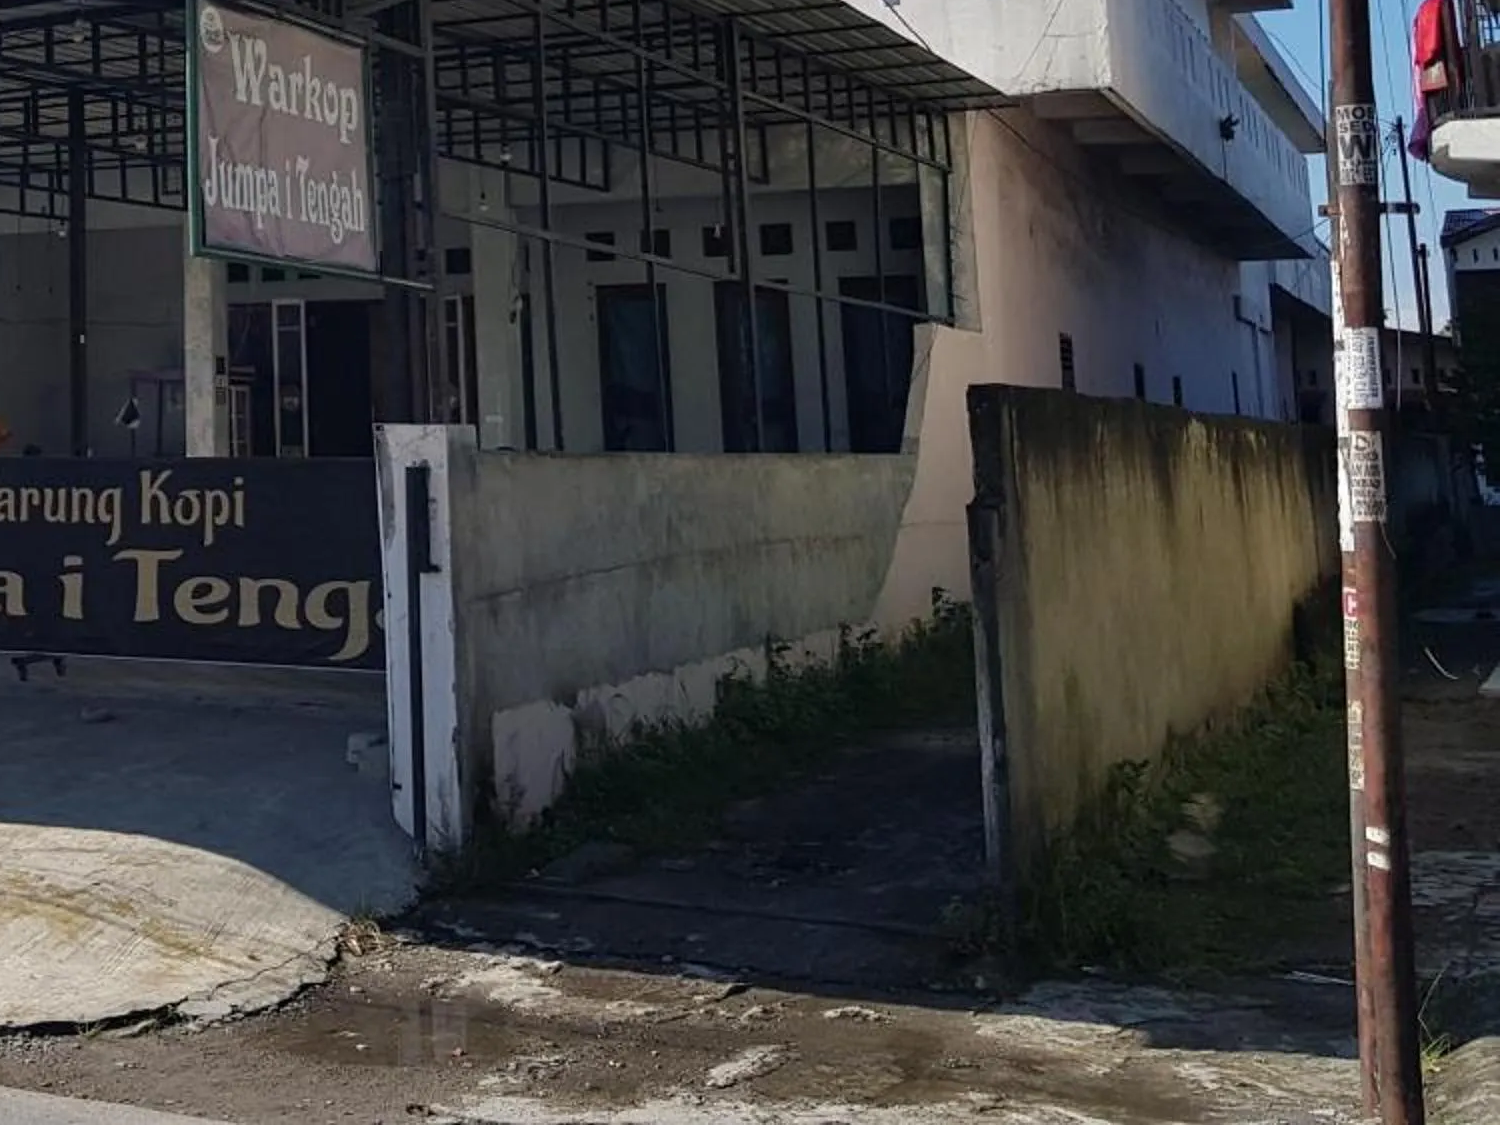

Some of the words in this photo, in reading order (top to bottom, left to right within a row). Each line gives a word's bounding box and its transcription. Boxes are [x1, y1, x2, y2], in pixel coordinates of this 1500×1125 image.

[226, 30, 359, 144] Warkop
[204, 134, 281, 230] Jumpa
[284, 160, 293, 220] i
[295, 155, 366, 245] Tengah
[138, 468, 247, 547] Kopi
[57, 554, 86, 622] i
[112, 548, 386, 663] Teng
